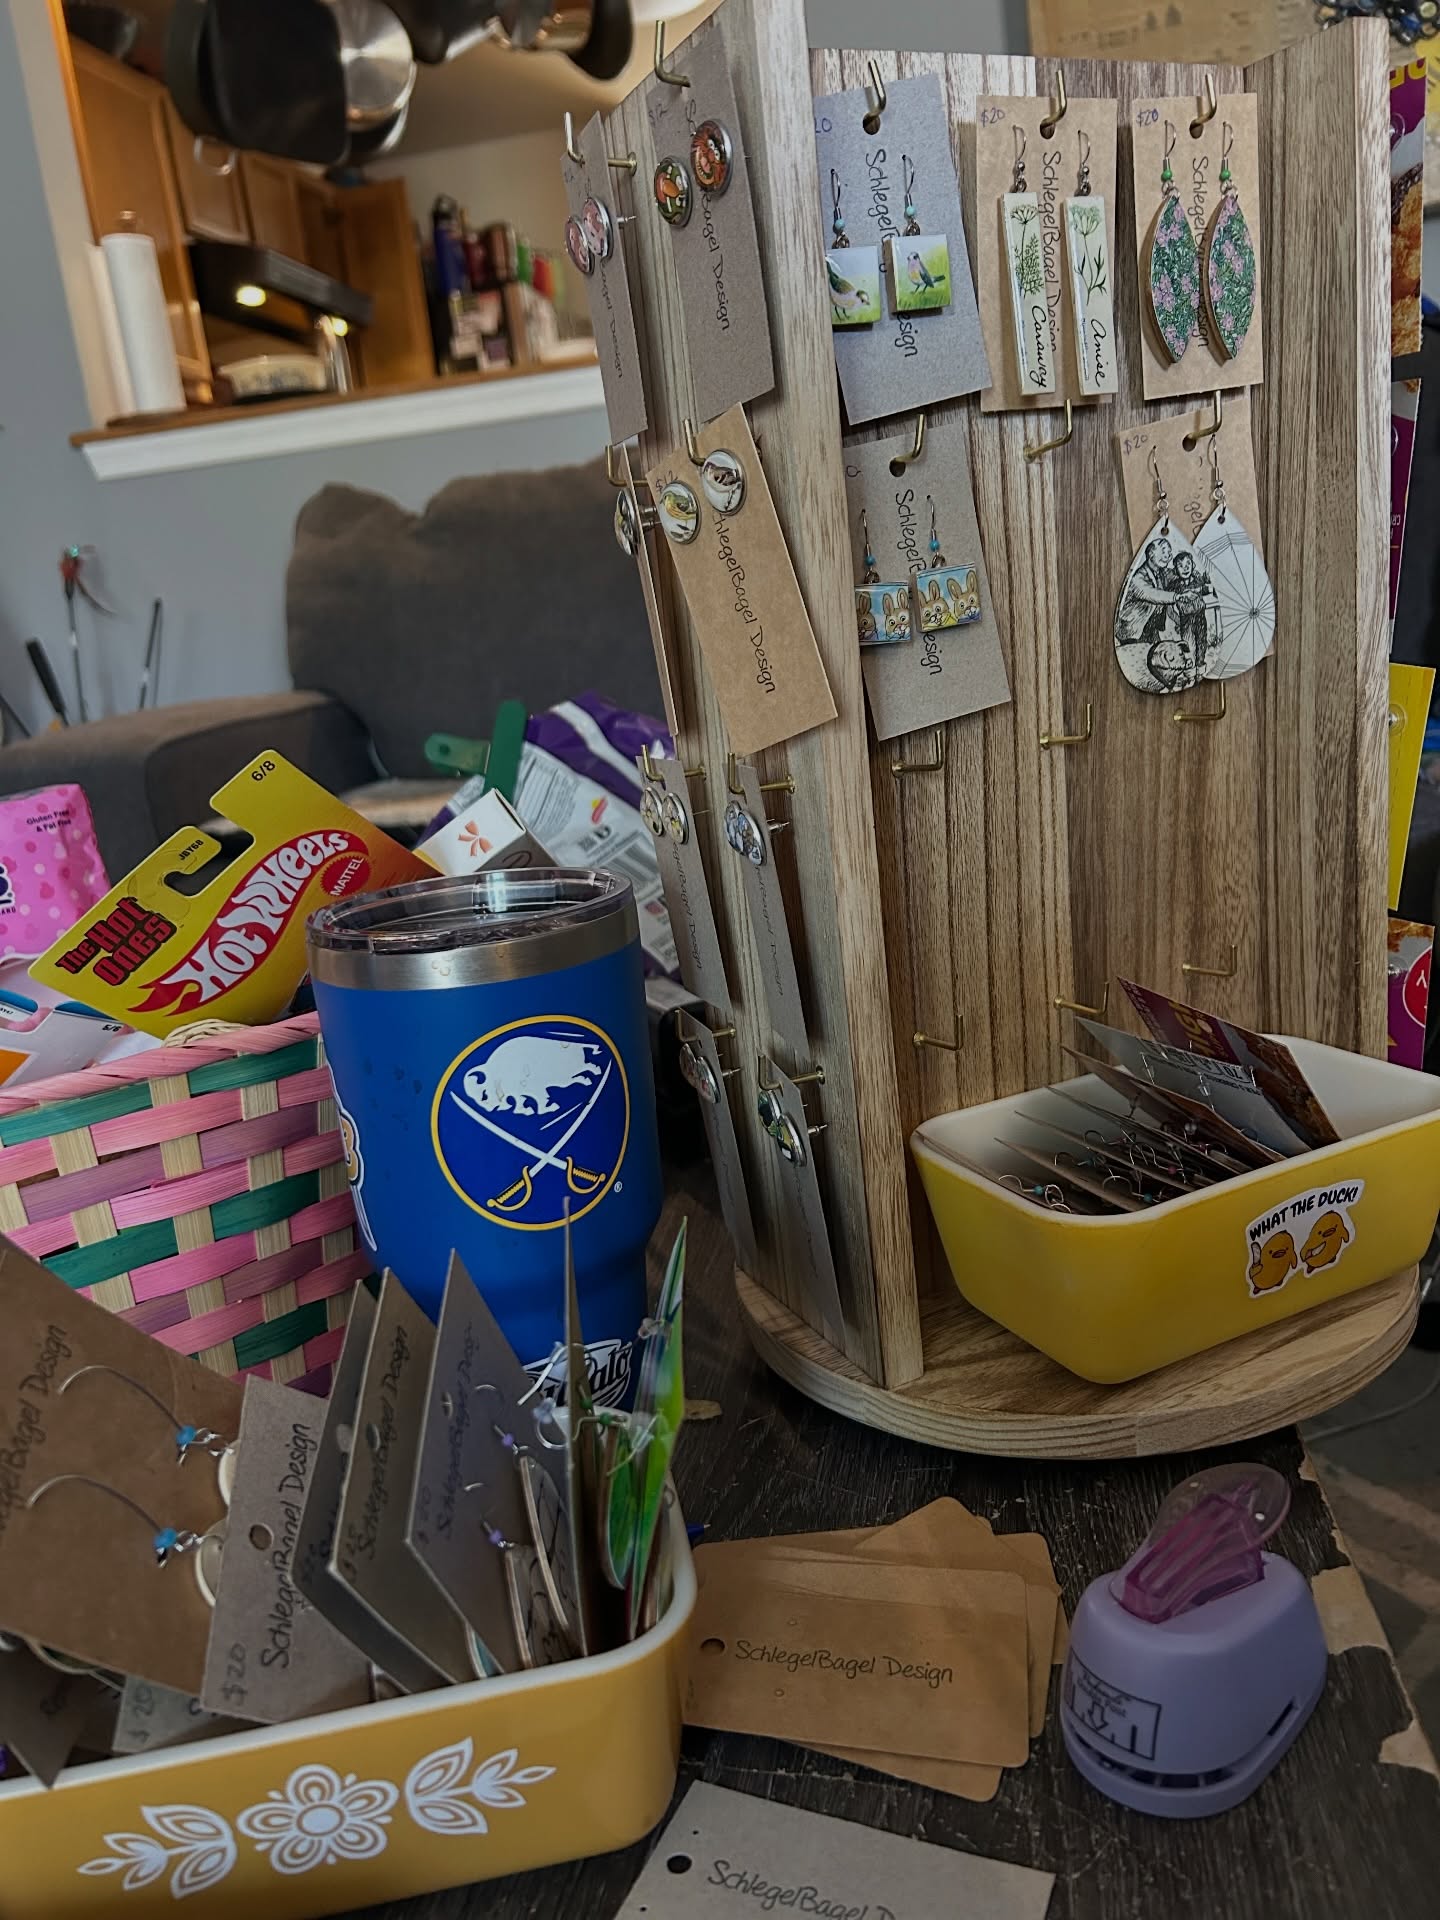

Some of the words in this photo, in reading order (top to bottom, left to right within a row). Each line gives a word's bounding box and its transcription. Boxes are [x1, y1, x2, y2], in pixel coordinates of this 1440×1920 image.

[980, 108, 1006, 127] $20
[1136, 108, 1160, 127] $20
[711, 258, 730, 331] Design
[894, 310, 918, 358] esign
[1123, 434, 1149, 456] $20
[711, 511, 758, 626] hlegelBagel
[749, 625, 777, 695] Design
[920, 630, 944, 676] esign
[251, 760, 276, 781] 6/8
[330, 857, 364, 897] MATTEL
[1249, 1206, 1289, 1242] WHAT
[1290, 1194, 1316, 1218] THE
[1318, 1186, 1359, 1208] DUCK!
[18, 1324, 73, 1397] Design
[278, 1423, 318, 1494] Design
[220, 1642, 248, 1706] $20
[735, 1639, 876, 1680] SchlegelBagel
[882, 1655, 954, 1689] Design
